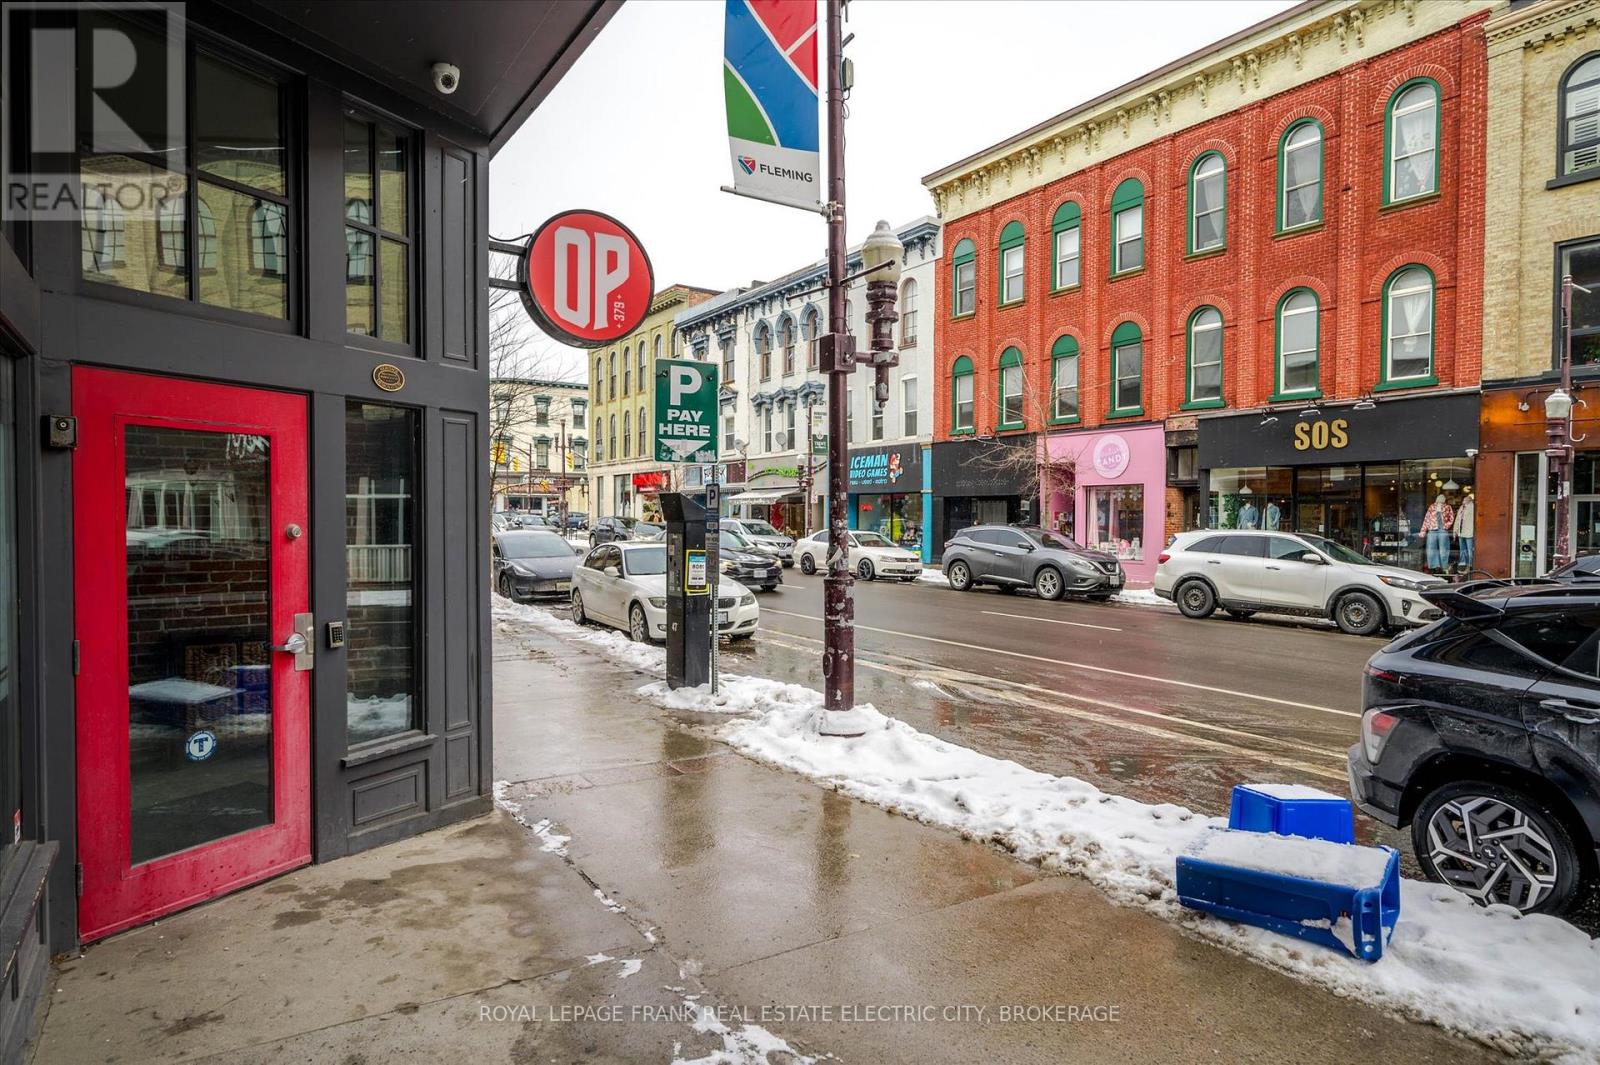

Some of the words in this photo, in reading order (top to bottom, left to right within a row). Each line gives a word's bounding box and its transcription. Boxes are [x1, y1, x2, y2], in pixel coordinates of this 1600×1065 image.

[759, 163, 813, 183] FLEMING
[554, 225, 630, 330] OP
[670, 364, 702, 406] P
[667, 409, 703, 422] PAY
[658, 423, 711, 437] HERE
[1294, 418, 1348, 450] SOS
[850, 453, 889, 469] ICEMAN
[849, 469, 866, 479] VIDEO
[866, 468, 888, 478] GAMES
[709, 489, 716, 506] P
